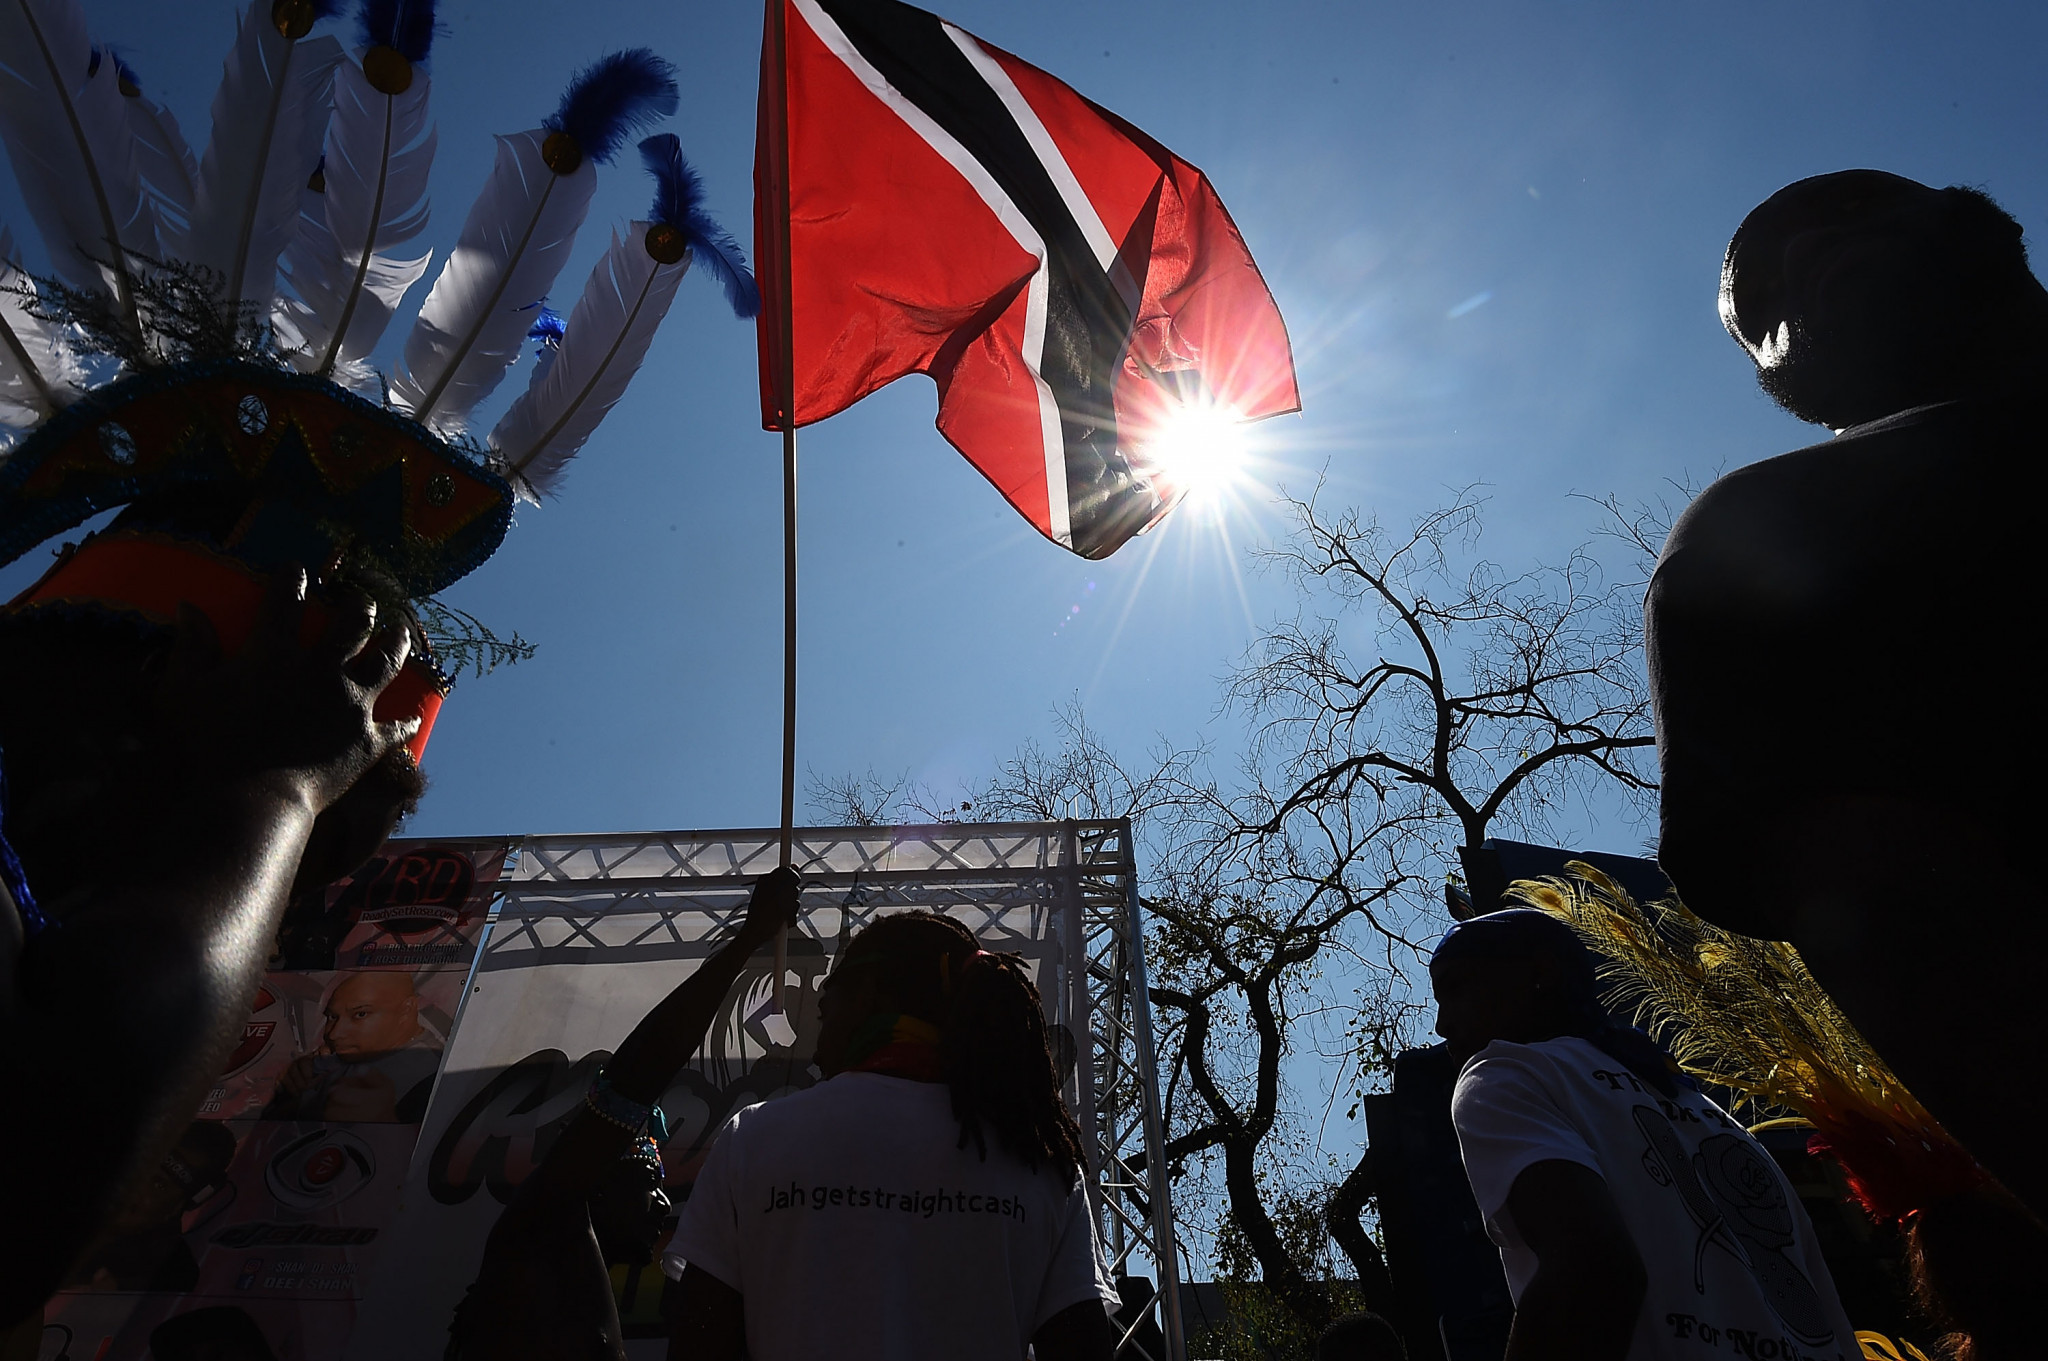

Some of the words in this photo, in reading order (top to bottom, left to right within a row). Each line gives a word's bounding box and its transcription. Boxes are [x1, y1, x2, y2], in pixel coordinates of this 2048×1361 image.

[361, 905, 455, 923] ReadySetRose.com
[764, 1182, 805, 1213] Jah
[1665, 1312, 1721, 1347] For
